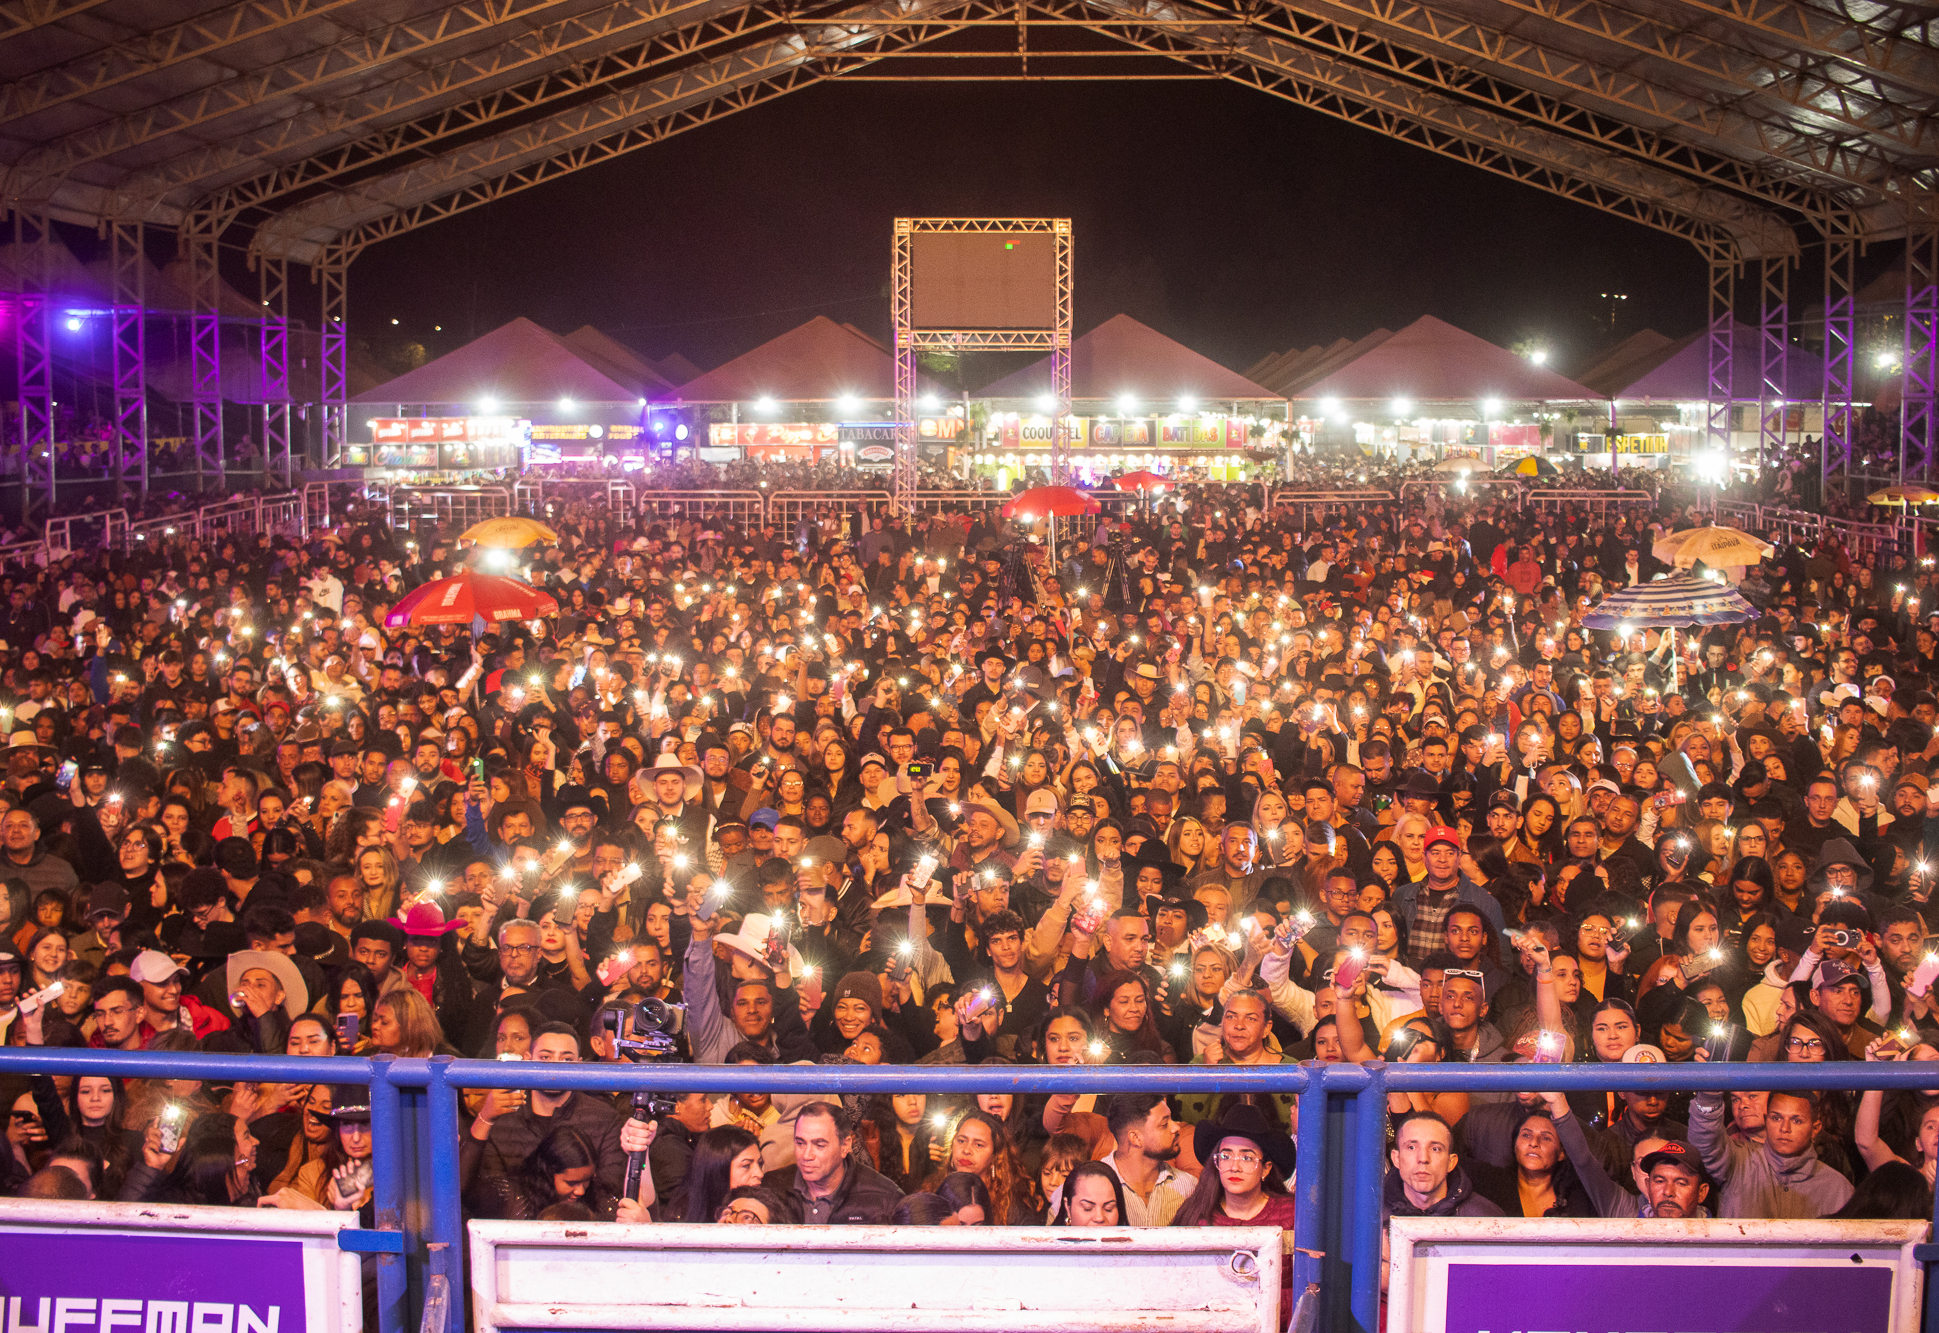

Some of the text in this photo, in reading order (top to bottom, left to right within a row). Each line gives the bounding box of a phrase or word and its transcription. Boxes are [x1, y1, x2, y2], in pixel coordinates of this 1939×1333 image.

[840, 427, 901, 440] TABACAR
[1022, 426, 1082, 440] COQUEL
[1095, 424, 1149, 443] CAPETA
[1162, 426, 1219, 443] BATIDAS
[493, 608, 523, 620] BRAHMA
[1517, 1036, 1538, 1045] GUC
[0, 1296, 281, 1333] UFFMAN
